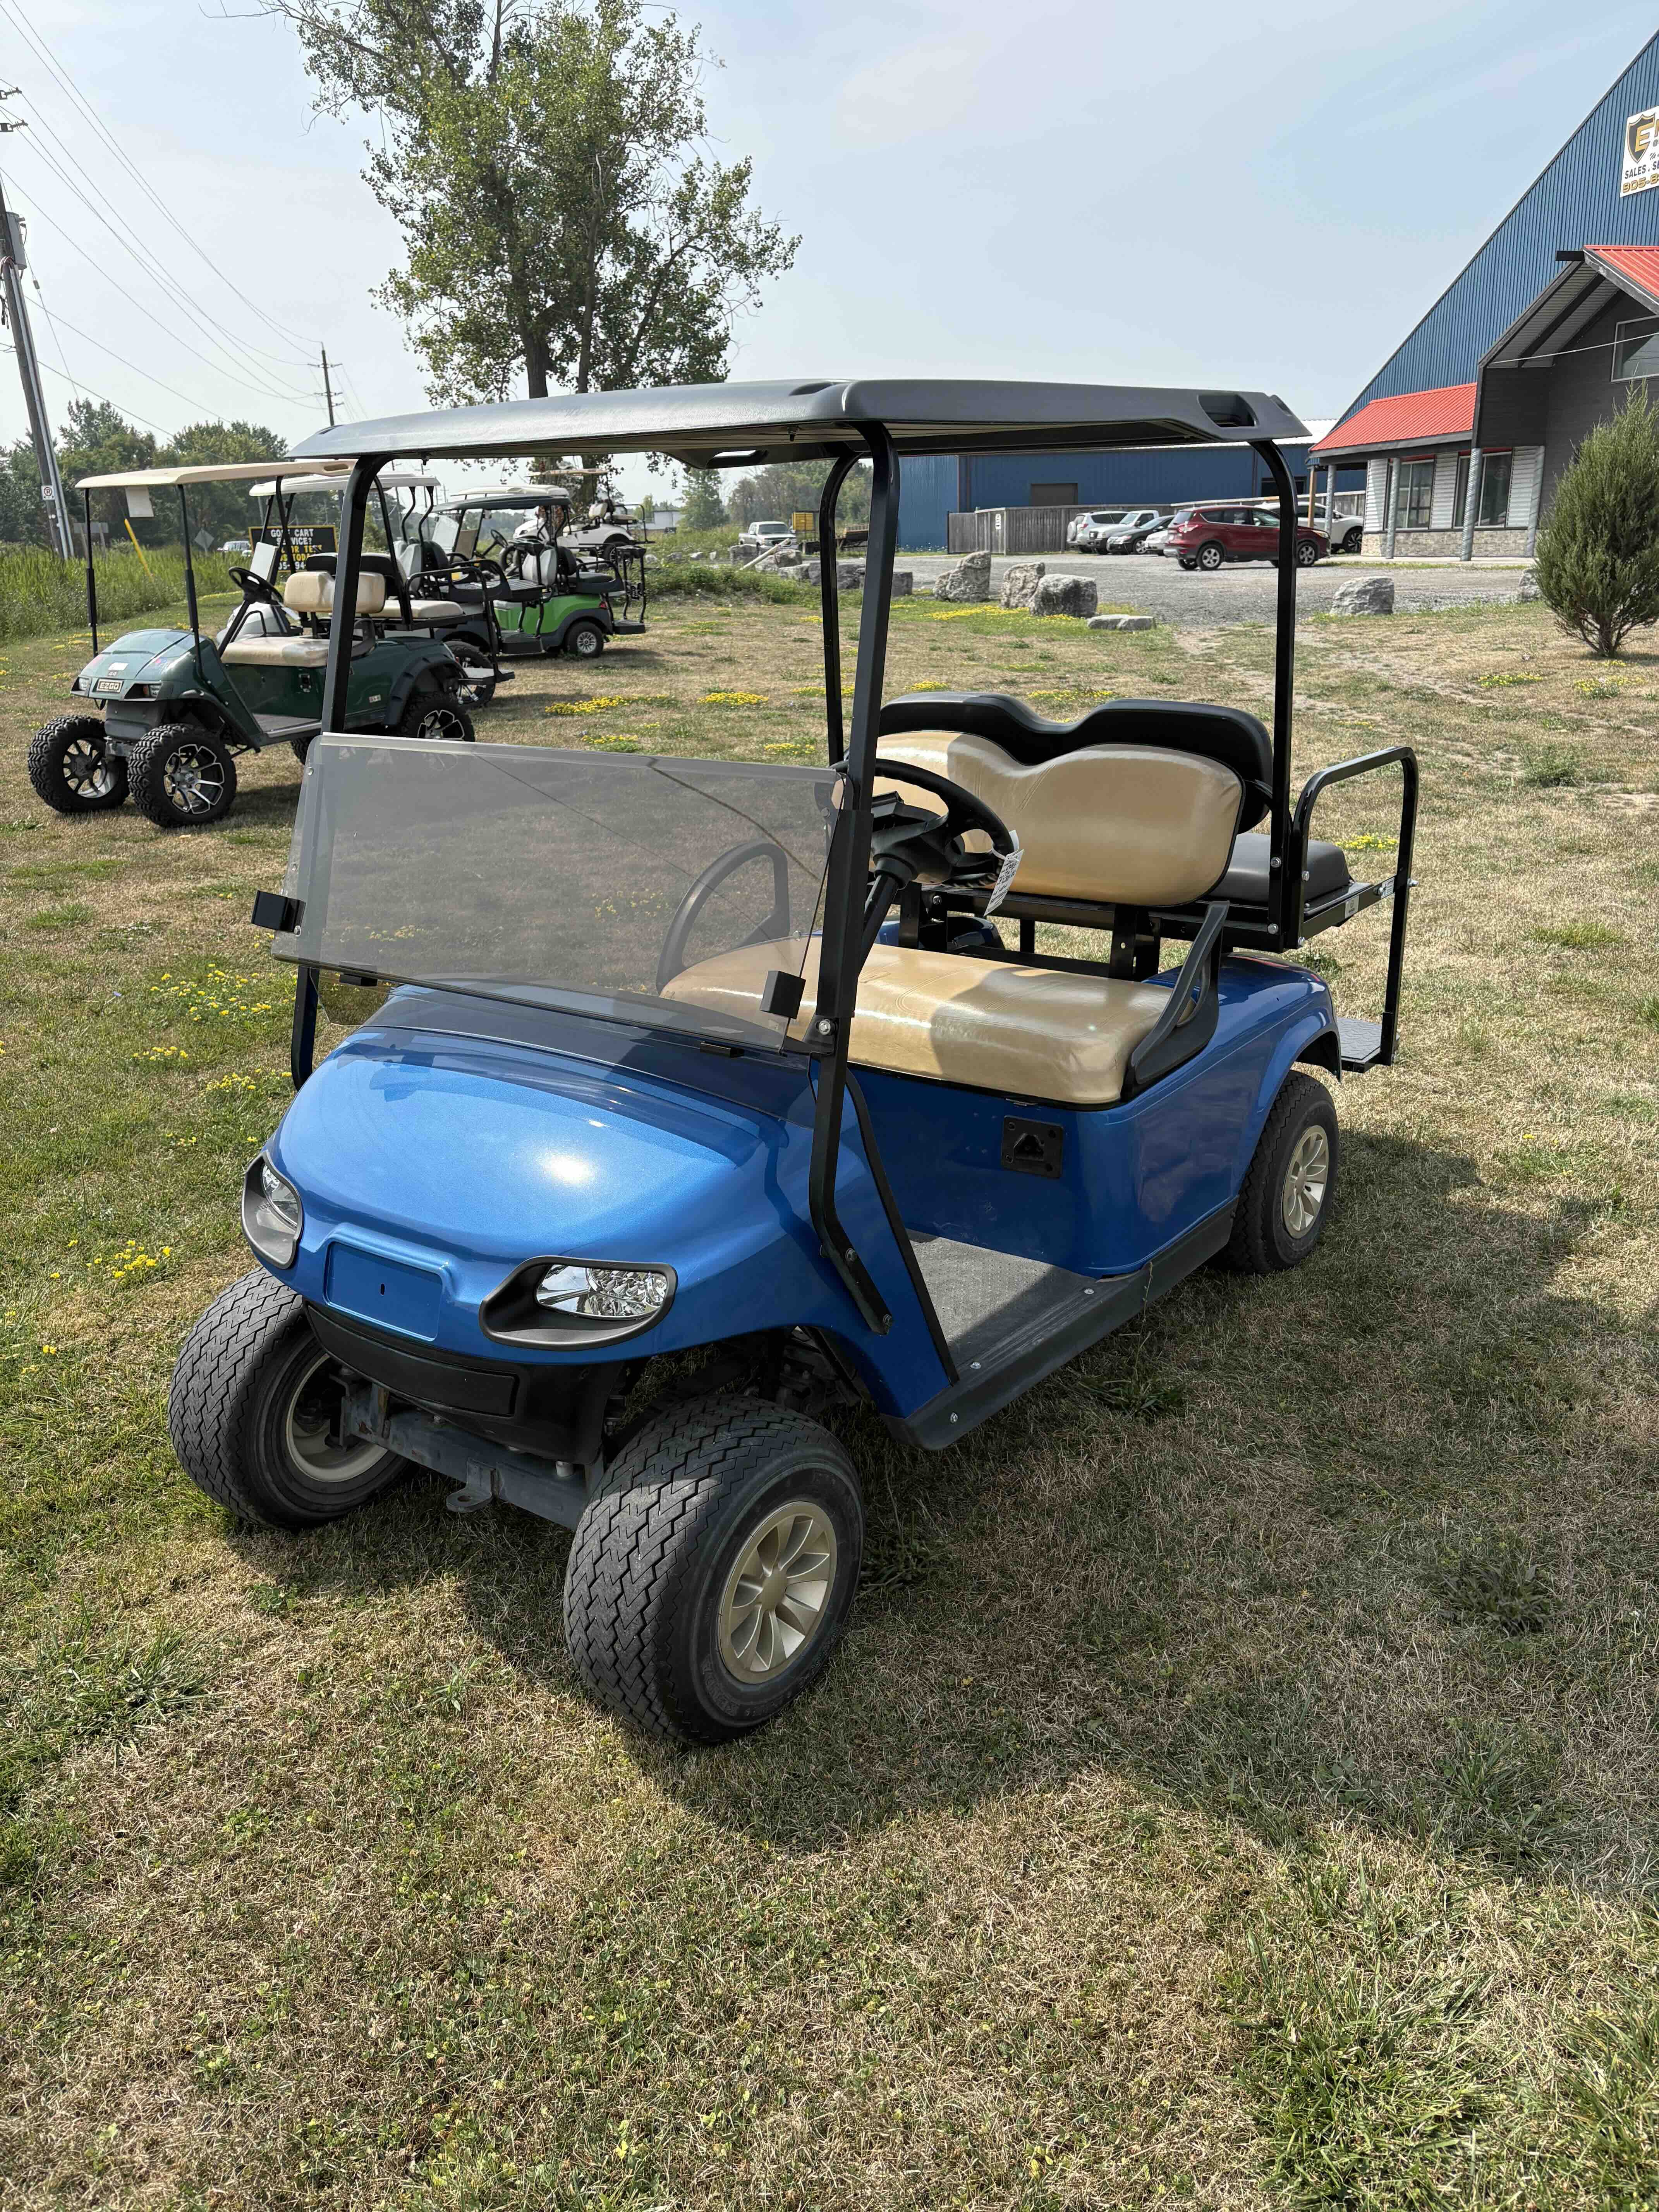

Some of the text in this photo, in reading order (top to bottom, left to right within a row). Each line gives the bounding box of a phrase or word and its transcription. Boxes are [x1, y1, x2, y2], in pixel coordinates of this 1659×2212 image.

[1625, 164, 1646, 179] SALES
[1623, 173, 1659, 192] 905-8
[294, 529, 314, 537] CART
[276, 537, 312, 546] SVICE?
[99, 682, 120, 690] EZGO
